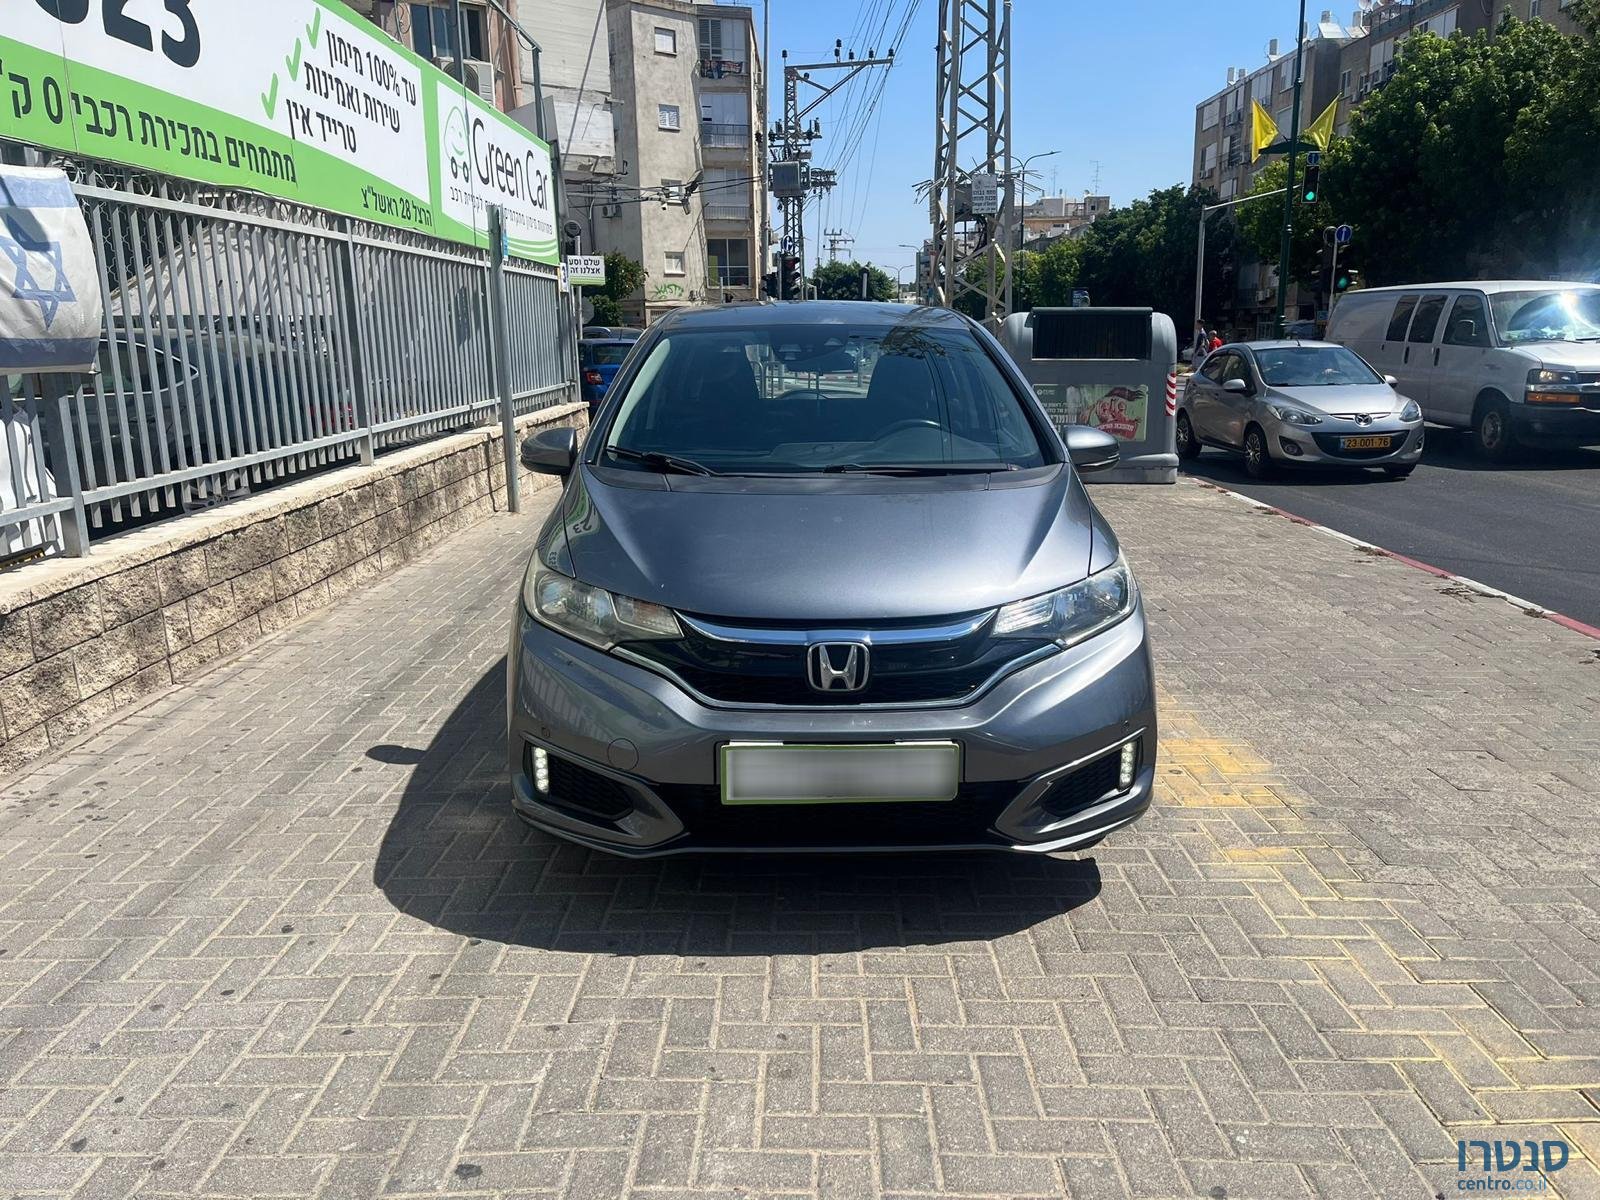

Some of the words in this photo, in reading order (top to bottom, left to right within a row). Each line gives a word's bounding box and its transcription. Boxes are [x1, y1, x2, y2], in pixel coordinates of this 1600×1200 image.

[326, 29, 364, 76] מימון
[304, 61, 361, 115] ואמינות
[366, 51, 401, 97] 100%
[401, 77, 416, 106] עד
[70, 91, 134, 142] רכבי
[286, 98, 314, 140] אין
[316, 111, 357, 153] טרייד
[363, 92, 400, 133] שירות
[138, 110, 222, 164] במכירת
[225, 136, 297, 183] מתמחים
[473, 117, 525, 201] Green
[526, 149, 548, 211] Car
[361, 184, 399, 217] ראשל"צ
[400, 197, 411, 220] 28
[412, 200, 433, 227] הרצל
[450, 186, 463, 203] רכב
[570, 266, 578, 274] זה
[581, 266, 601, 274] אצלנו
[584, 258, 600, 266] שלם
